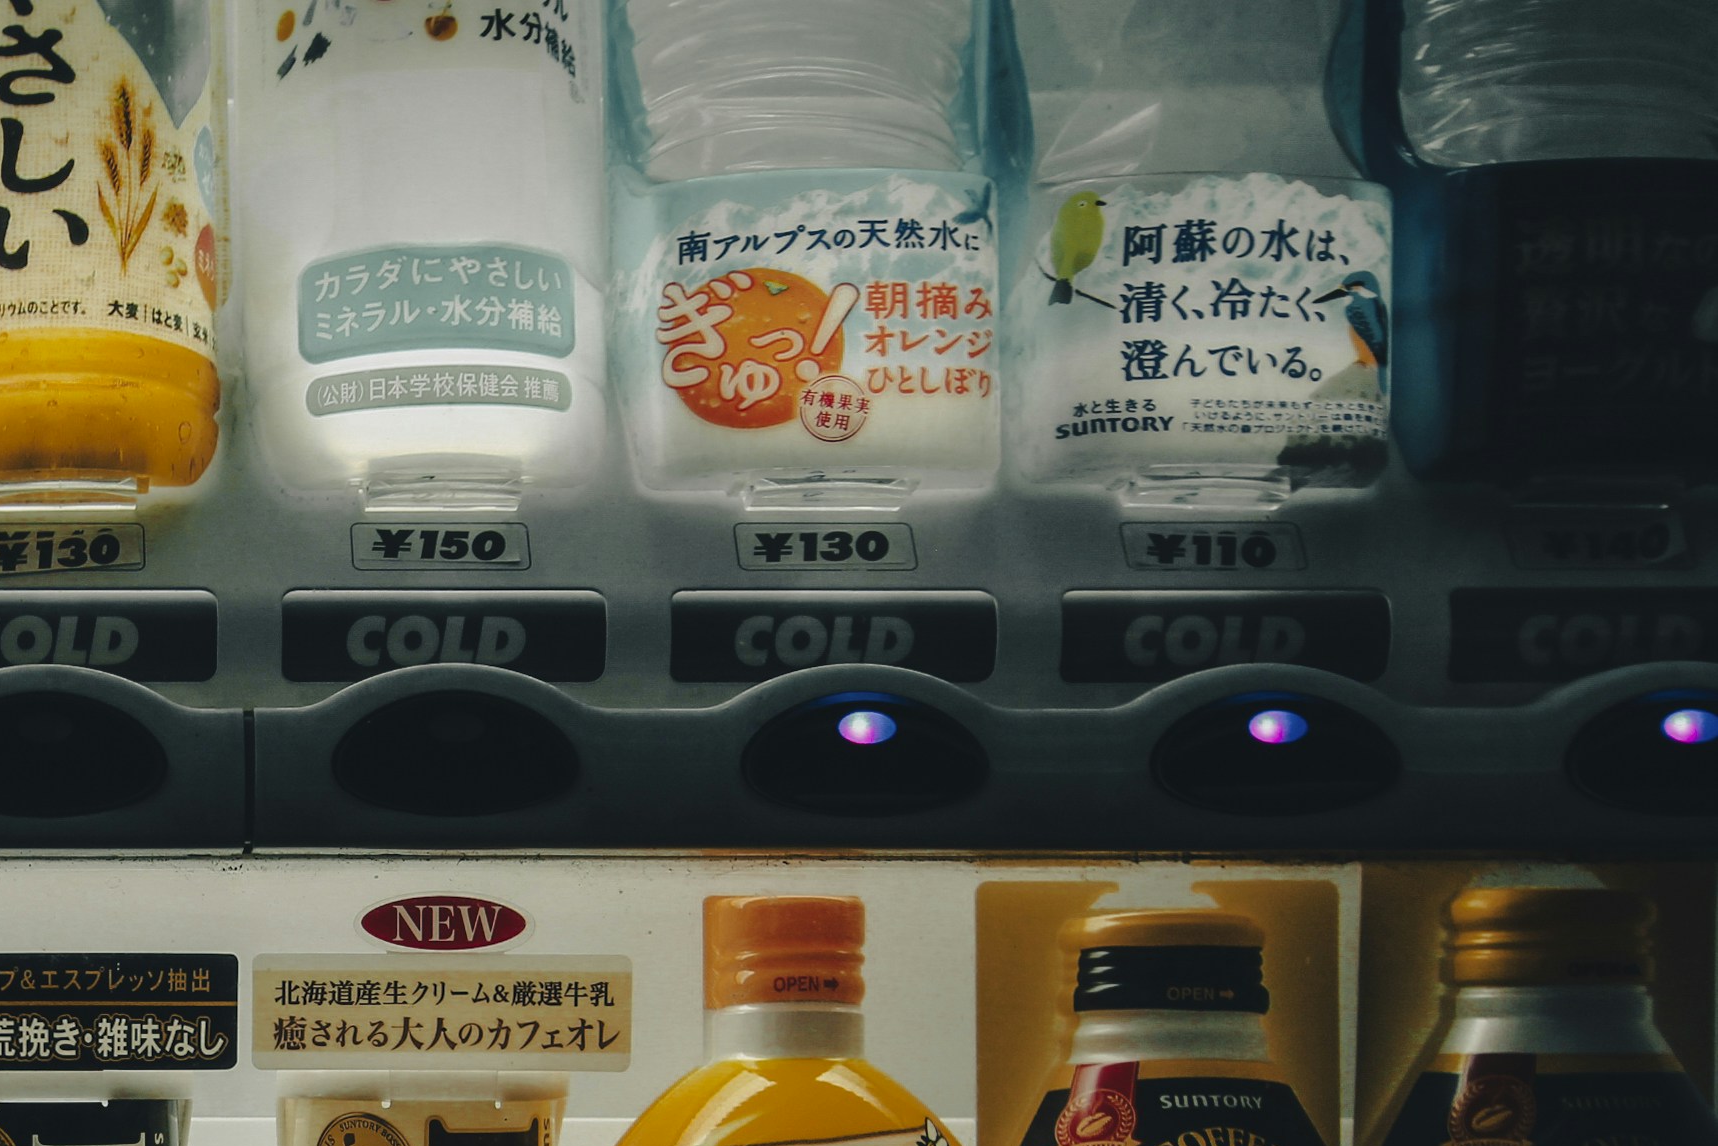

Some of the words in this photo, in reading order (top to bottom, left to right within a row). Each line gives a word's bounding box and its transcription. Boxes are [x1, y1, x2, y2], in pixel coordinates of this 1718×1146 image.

[677, 217, 980, 266] 南アルプスの天然水に
[1123, 220, 1350, 266] 阿蘇の水は、
[313, 257, 562, 301] カラダにやさしい
[864, 281, 993, 319] 朝摘み
[1119, 278, 1327, 323] 清く、冷たく、
[314, 298, 563, 341] ミネラル・水分補給
[864, 325, 993, 357] オレンジ
[1120, 339, 1323, 382] 澄んでいる。
[866, 365, 991, 399] ひとしぼり
[799, 386, 871, 417] 有機果実
[1073, 399, 1157, 416] 水と生きる
[813, 409, 852, 431] 使用
[1055, 416, 1174, 439] SUNTORY
[372, 529, 506, 561] ¥150
[753, 531, 890, 562] ¥130
[1147, 531, 1277, 567] ¥110
[346, 615, 526, 666] COLD
[734, 615, 914, 666] COLD
[1123, 614, 1306, 668] COLD
[392, 905, 503, 941] NEW
[274, 979, 614, 1008] 北海道産生クリーム&厳選牛乳
[774, 976, 820, 993] OPEN
[1166, 986, 1215, 1000] OPEN
[273, 1015, 620, 1051] 癒される大人のカフェオレ
[1159, 1093, 1263, 1110] SUNTORY
[339, 1120, 382, 1133] SUNTORY
